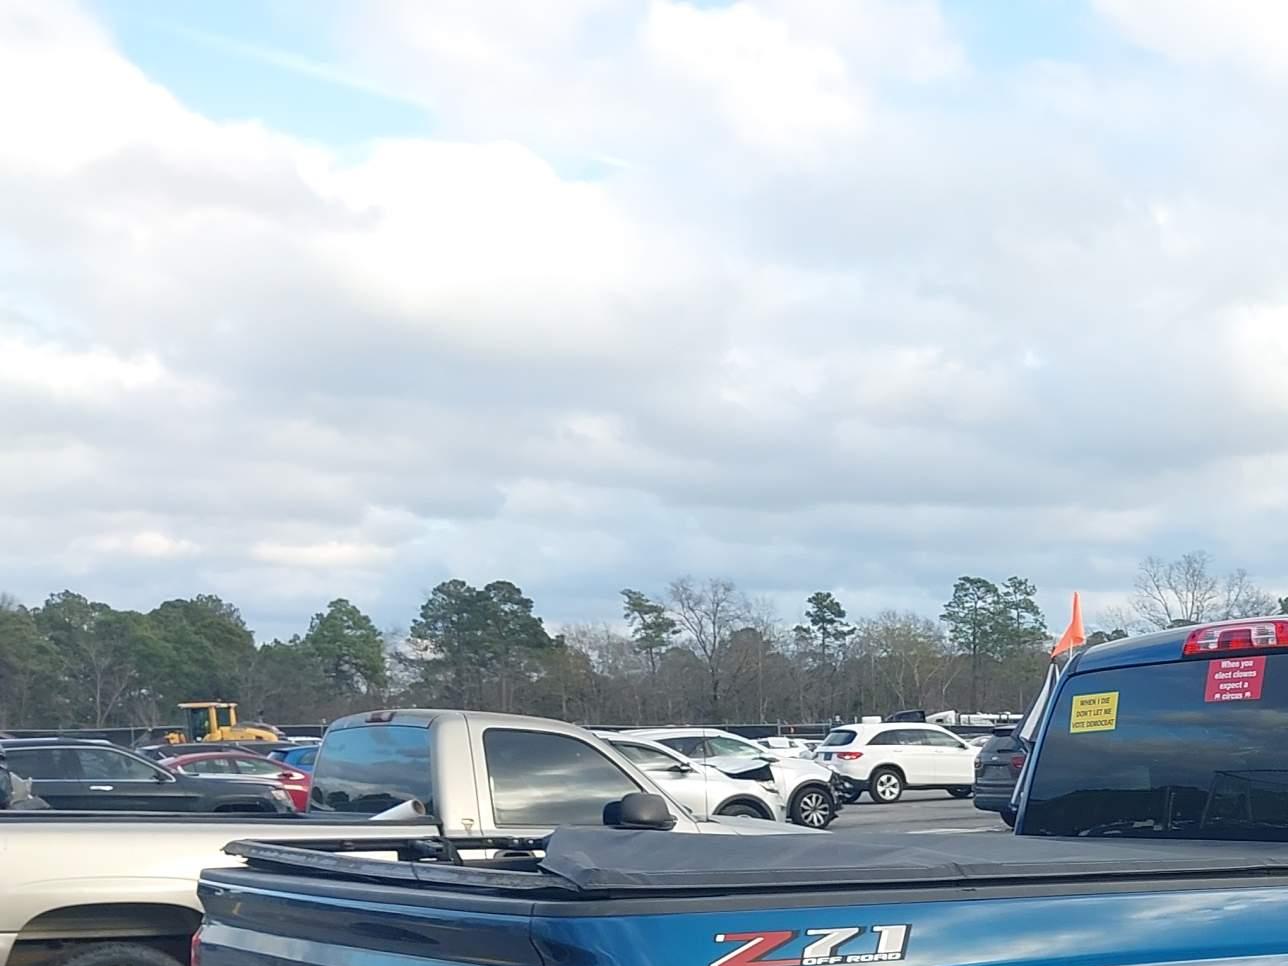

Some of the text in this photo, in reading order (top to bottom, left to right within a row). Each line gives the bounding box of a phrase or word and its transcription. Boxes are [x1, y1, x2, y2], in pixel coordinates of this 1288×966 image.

[1241, 660, 1254, 669] you
[802, 952, 902, 966] OFF ROAD
